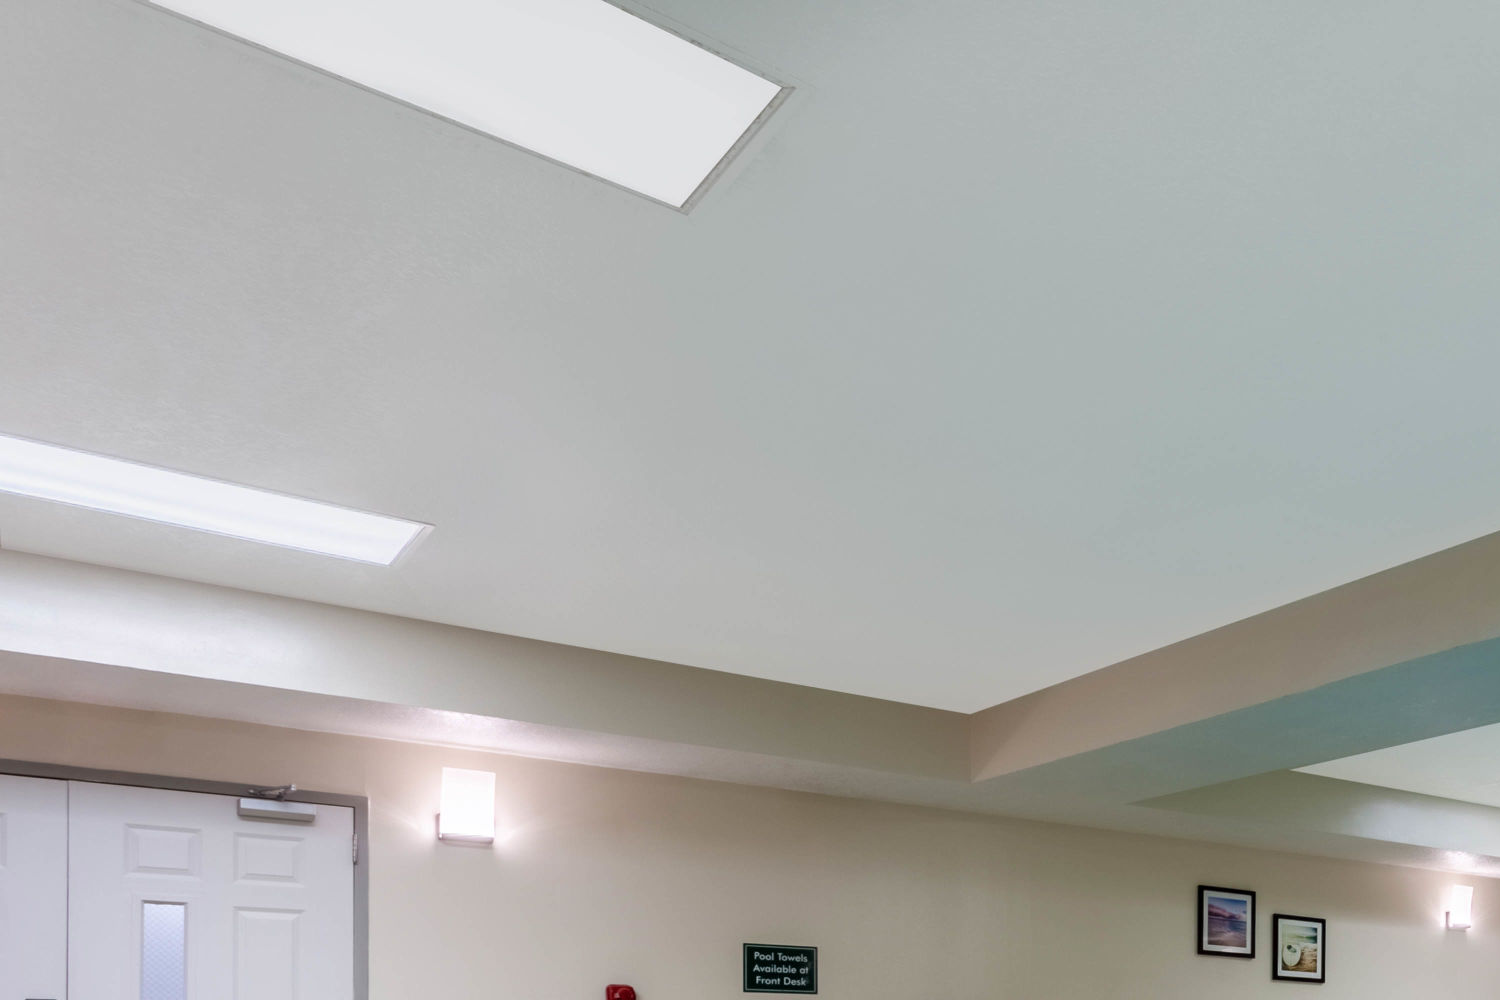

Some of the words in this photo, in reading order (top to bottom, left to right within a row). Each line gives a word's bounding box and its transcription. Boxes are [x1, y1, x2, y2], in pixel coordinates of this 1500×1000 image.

[753, 951, 775, 961] Pool
[777, 952, 808, 963] Towels
[752, 964, 797, 974] Available
[799, 966, 809, 975] at
[755, 976, 780, 985] Front
[783, 977, 807, 987] Desk
